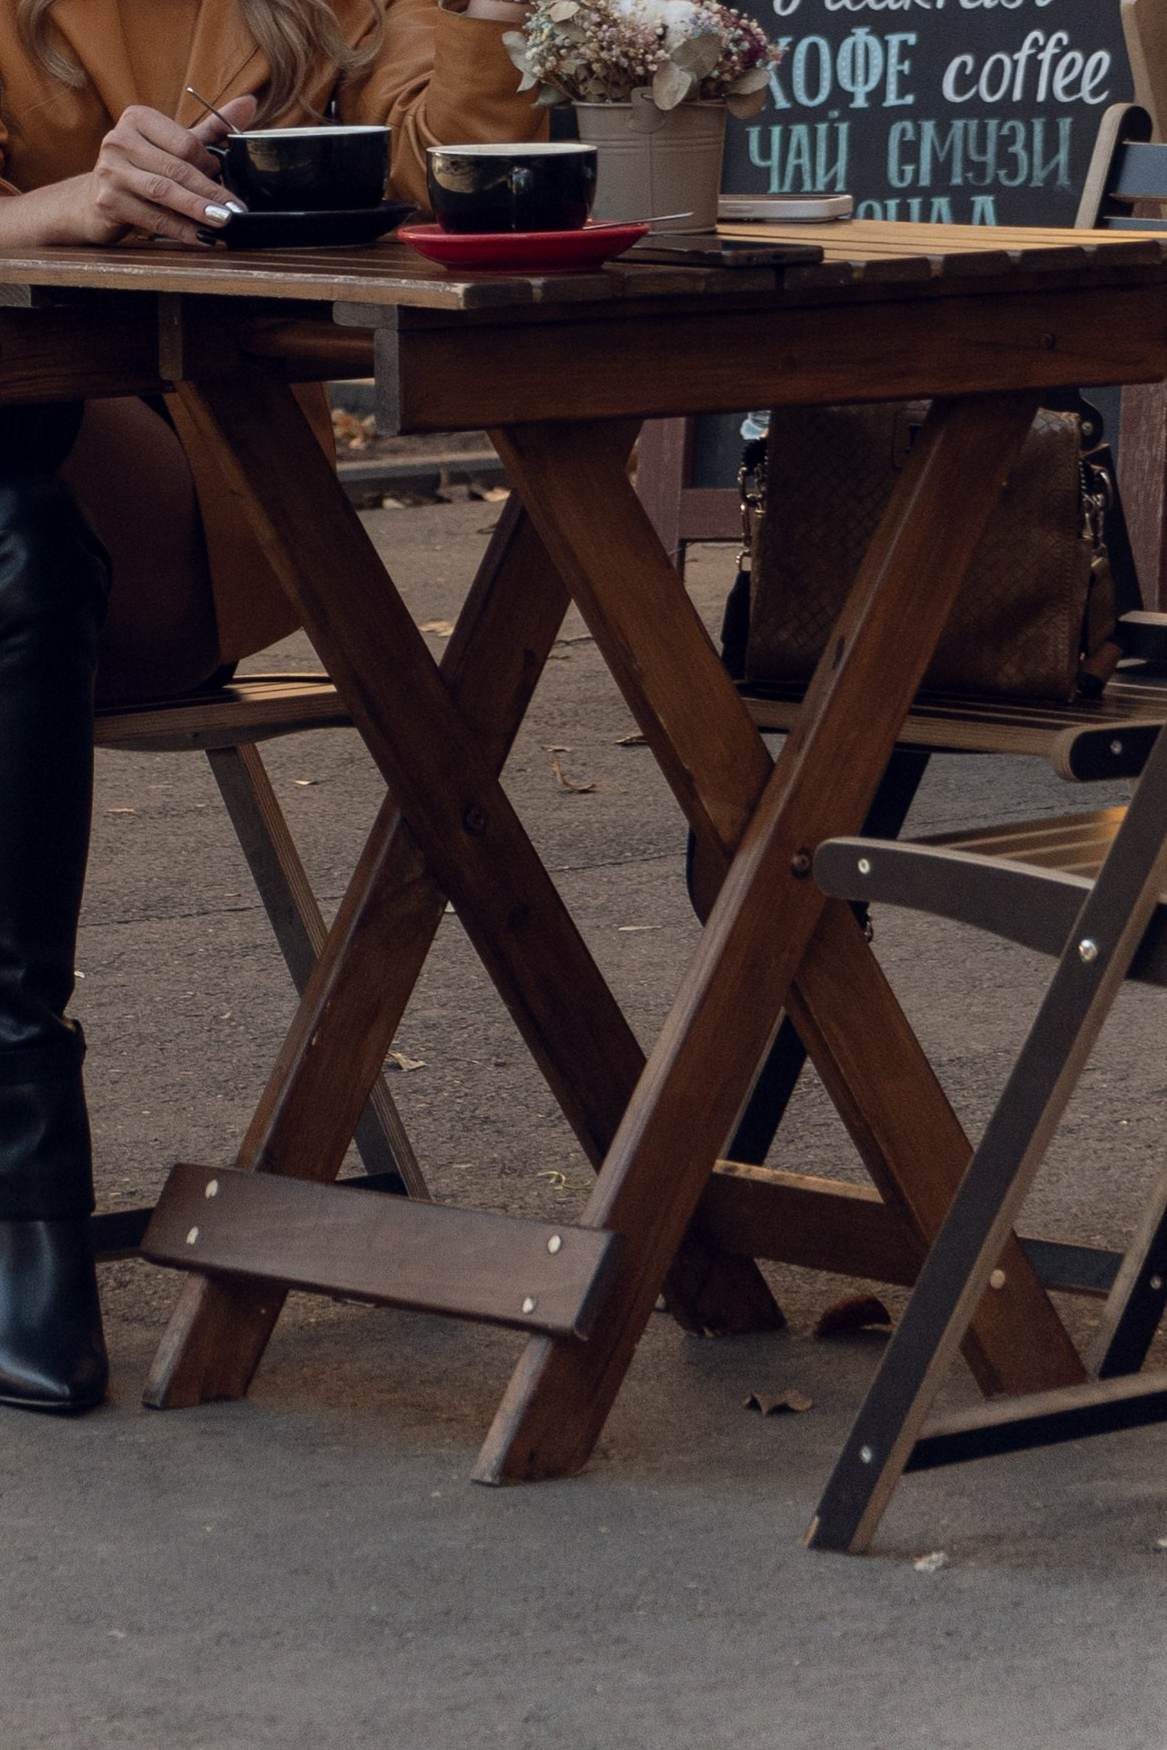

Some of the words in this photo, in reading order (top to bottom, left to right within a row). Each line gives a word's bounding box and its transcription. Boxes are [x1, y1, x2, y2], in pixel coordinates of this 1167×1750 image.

[942, 30, 1112, 105] coffee
[745, 110, 850, 194] ЧАЙ
[887, 116, 1073, 190] СМУЗИ
